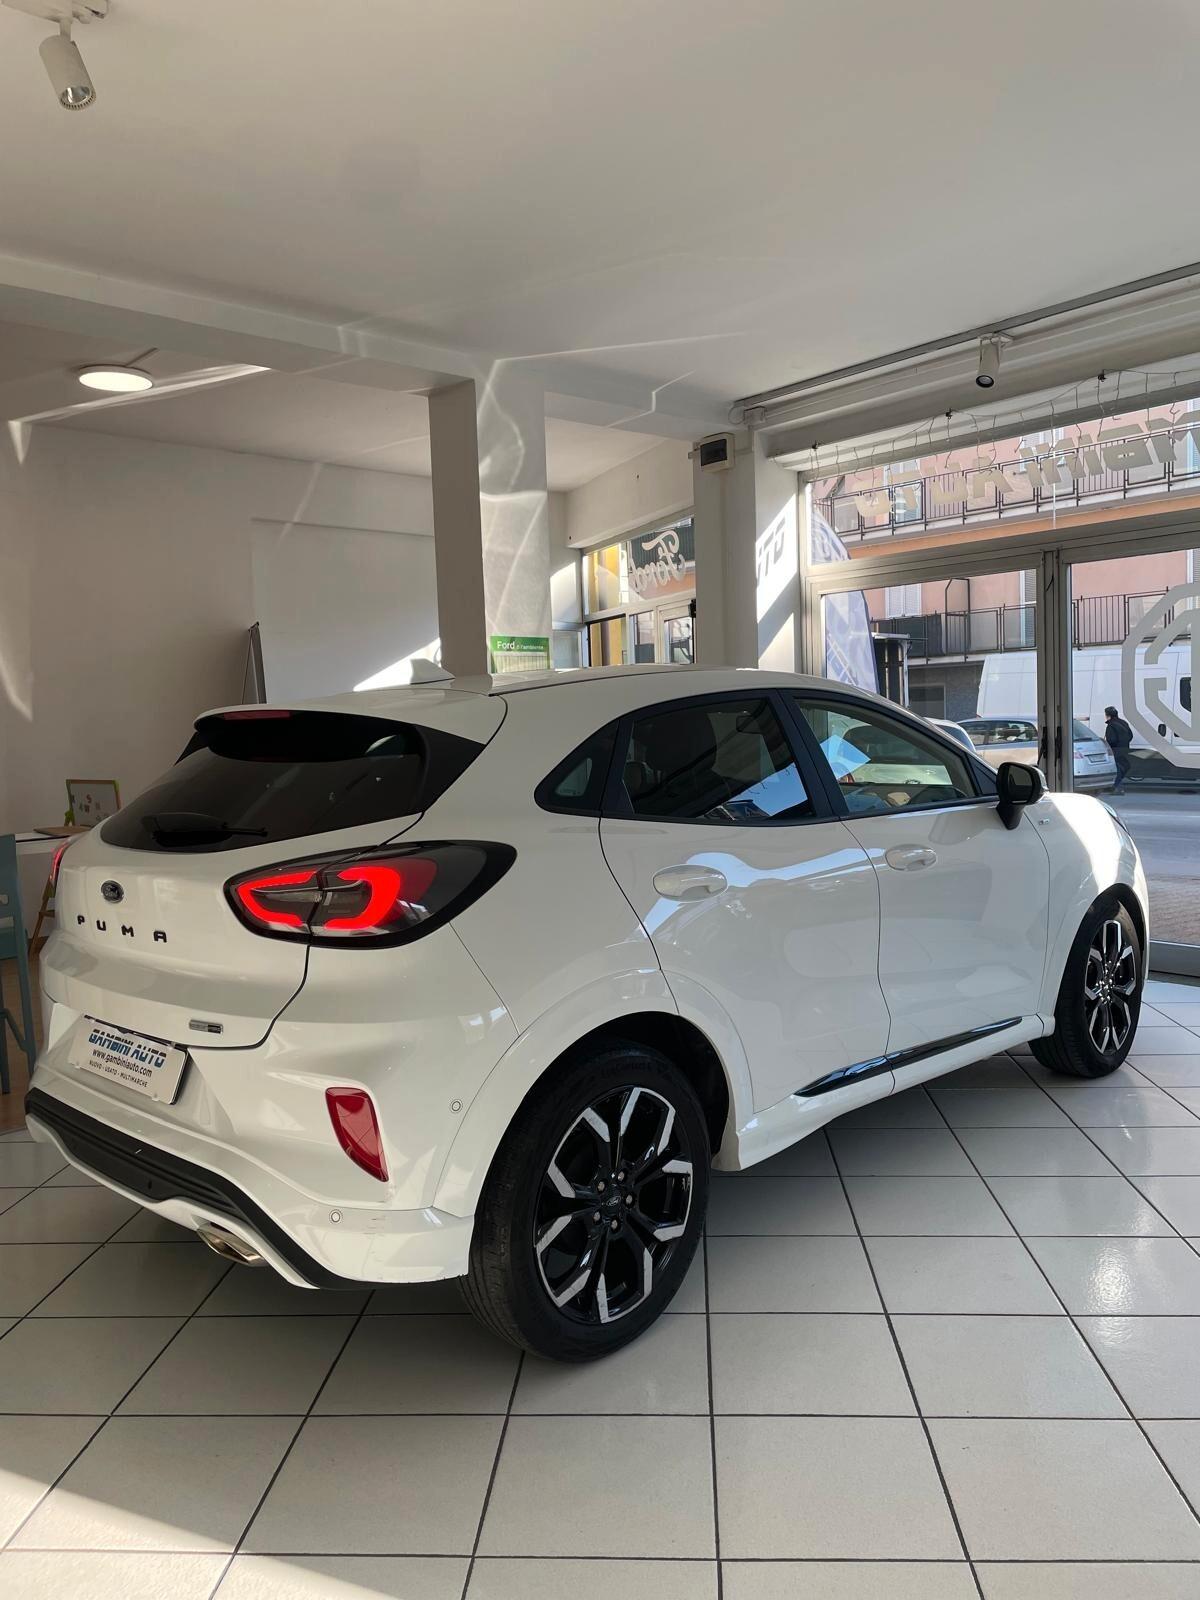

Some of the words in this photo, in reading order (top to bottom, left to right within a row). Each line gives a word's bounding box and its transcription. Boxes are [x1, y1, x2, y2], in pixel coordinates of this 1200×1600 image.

[497, 640, 515, 650] Ford
[77, 914, 168, 943] PUMA
[88, 1028, 134, 1055] GAMBINI
[130, 1044, 167, 1068] AUTO
[89, 1059, 102, 1069] NUOVO
[105, 1066, 117, 1075] USATO
[120, 1072, 148, 1087] MULTIMARCHE
[92, 1049, 153, 1078] www.gambiniauto.com
